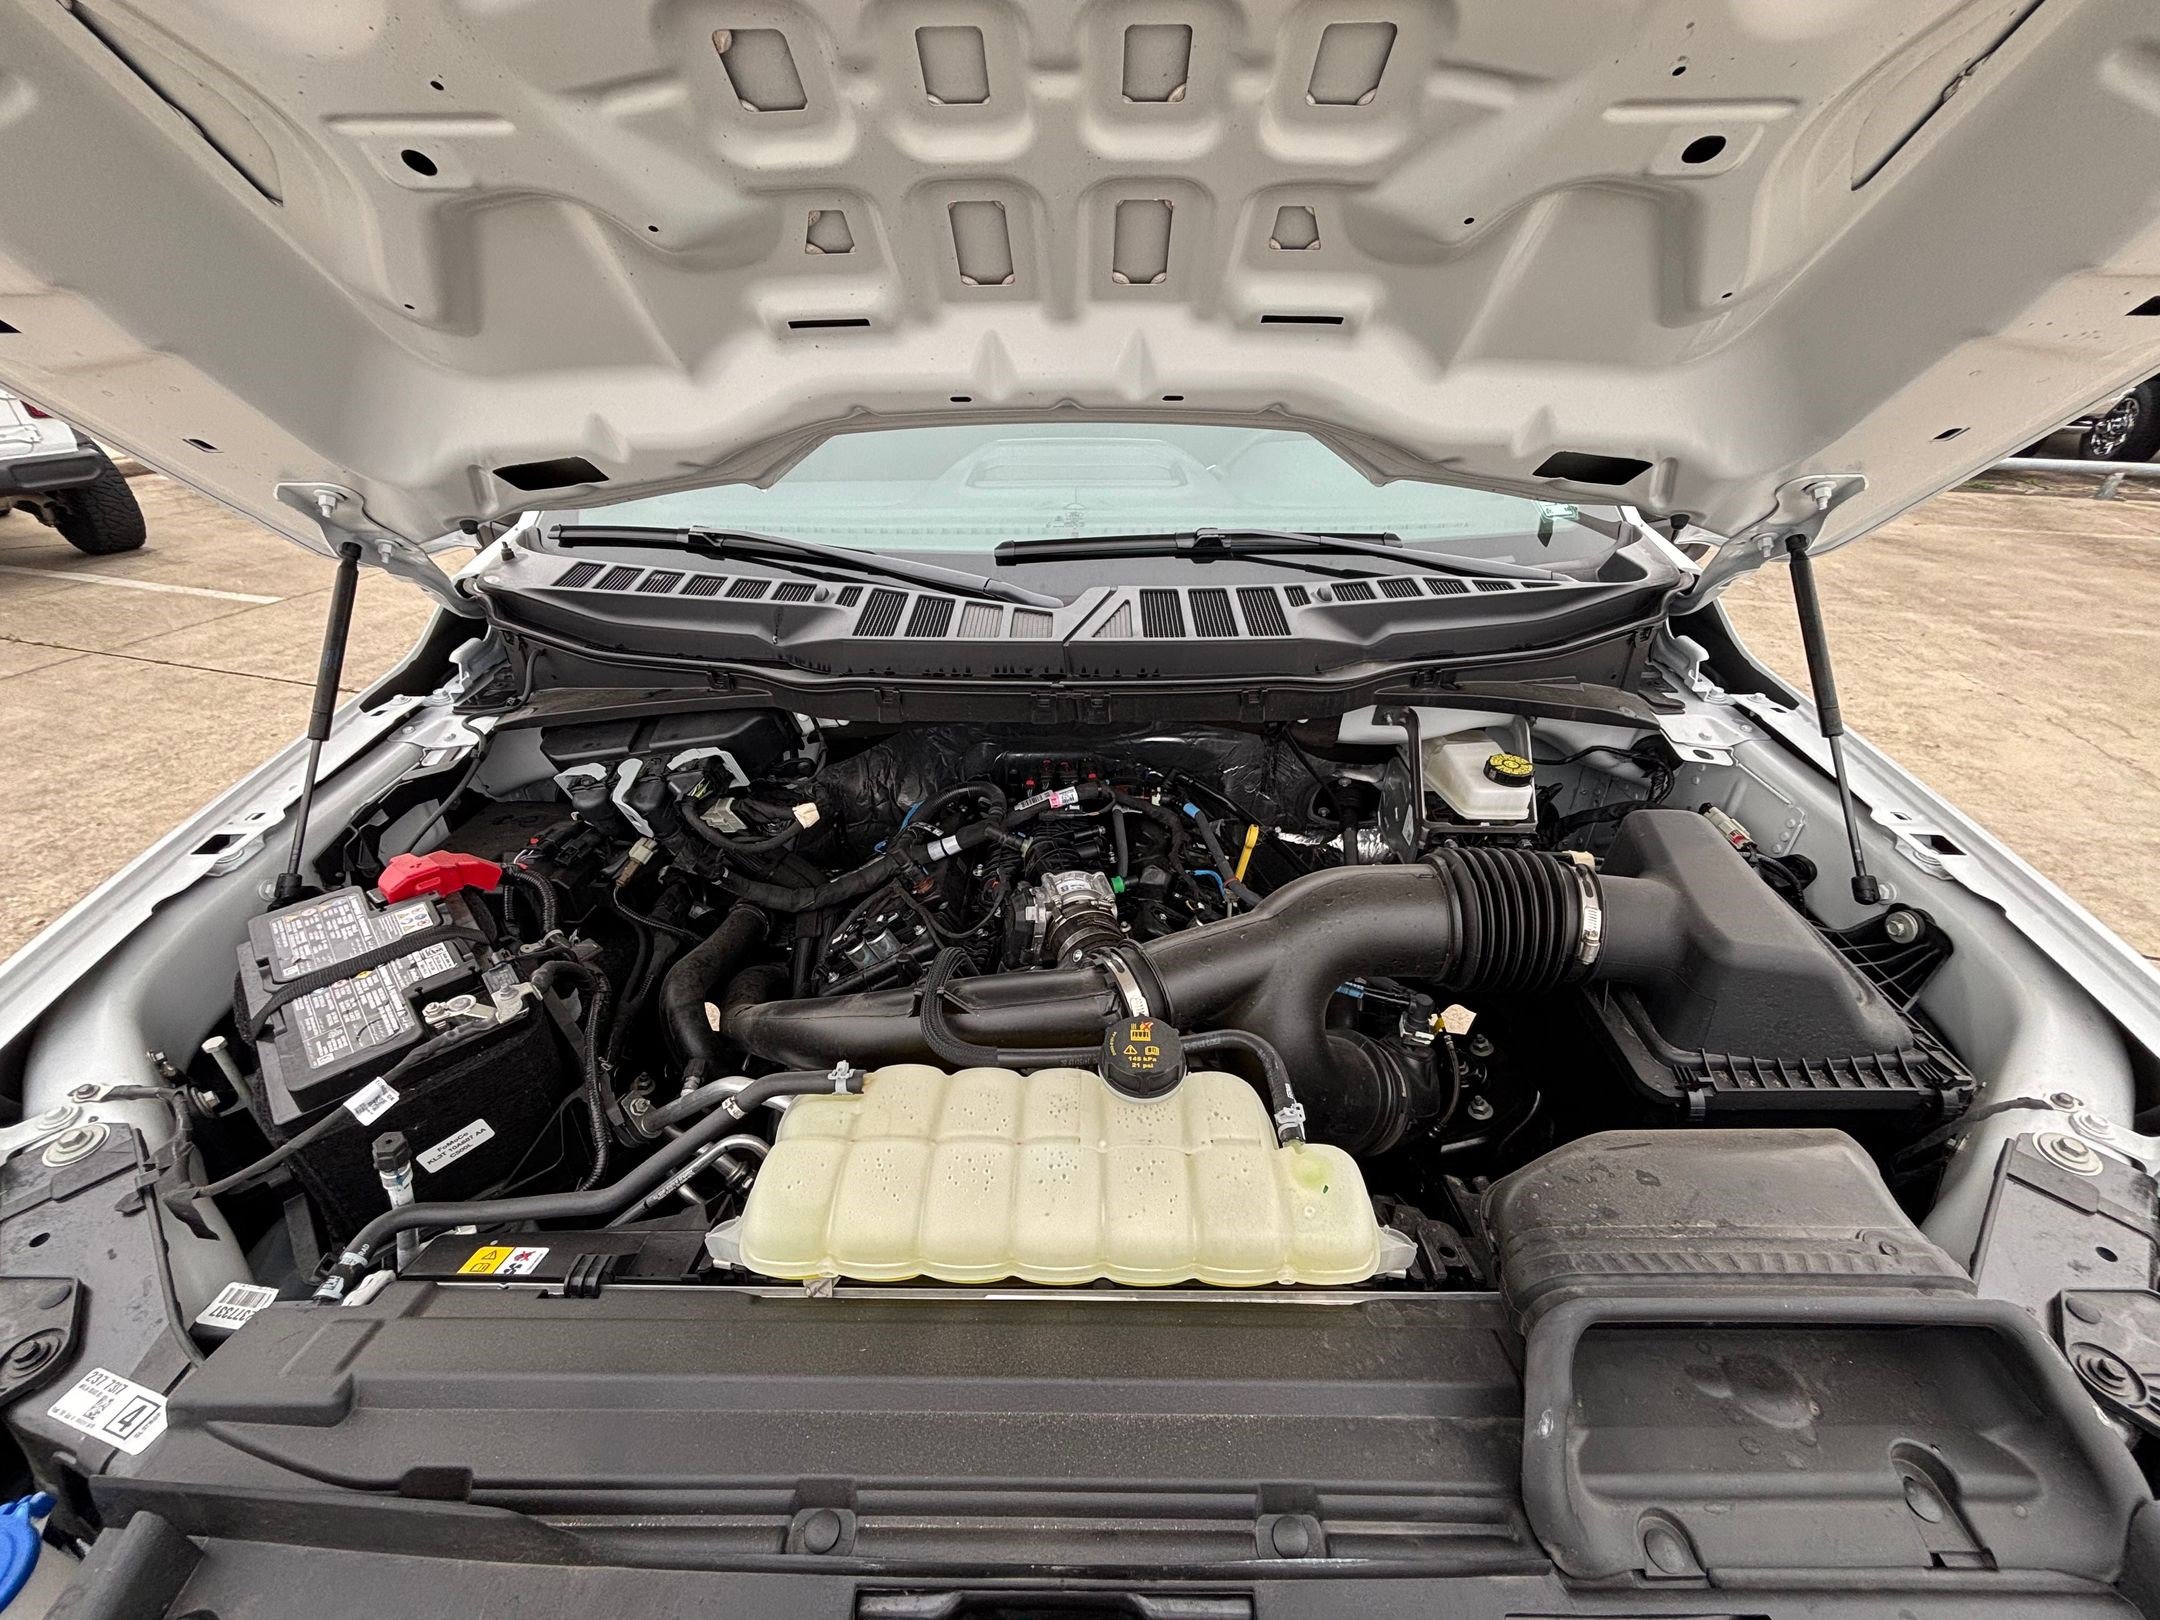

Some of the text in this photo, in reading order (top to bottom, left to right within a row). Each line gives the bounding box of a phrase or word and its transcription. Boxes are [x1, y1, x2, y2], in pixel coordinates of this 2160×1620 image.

[437, 1132, 469, 1152] FoMoCo
[475, 1127, 486, 1137] AA
[117, 1404, 148, 1433] 4
